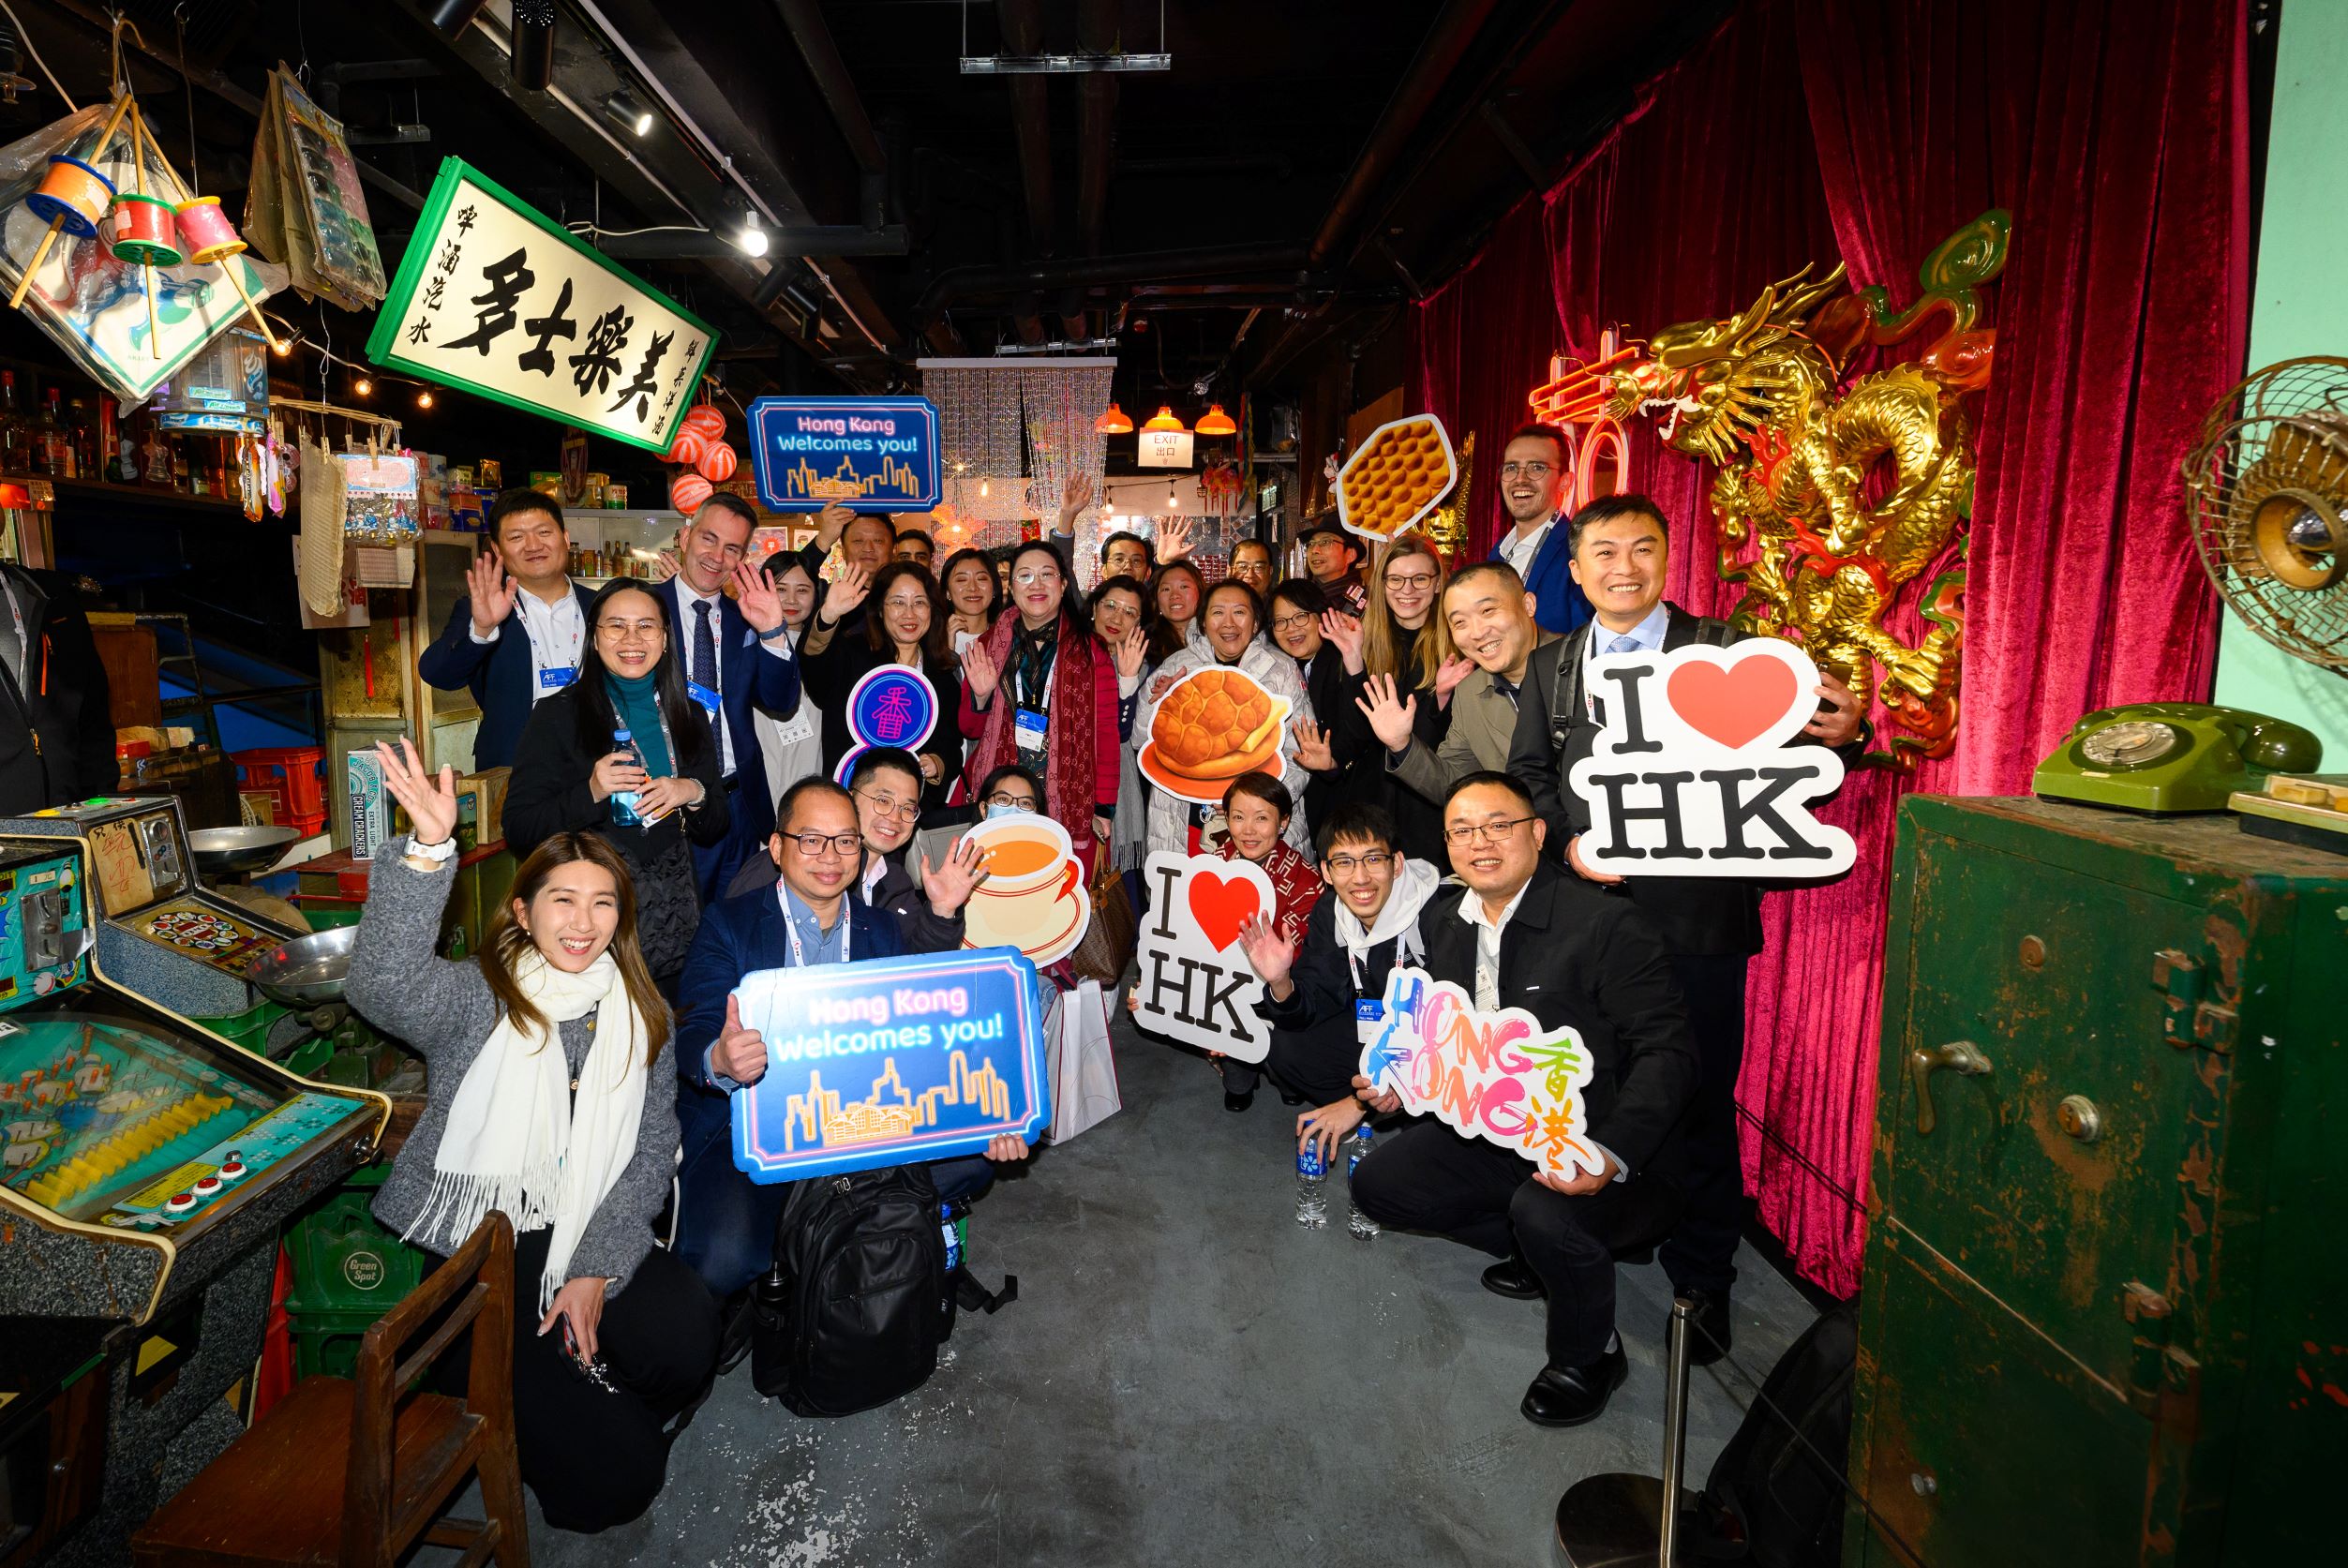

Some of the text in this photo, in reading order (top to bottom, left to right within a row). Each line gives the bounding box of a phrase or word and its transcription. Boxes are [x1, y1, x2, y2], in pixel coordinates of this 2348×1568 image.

[778, 435, 918, 455] Welcomes you!
[798, 416, 895, 435] Hong Kong
[1154, 434, 1179, 444] EXIT
[1156, 445, 1175, 456] 出口
[871, 685, 913, 739] 香
[1603, 665, 1664, 755] I
[352, 760, 377, 782] JACOB
[352, 796, 366, 855] CREAM CRACKERS
[1588, 765, 1833, 860] HK
[1151, 866, 1183, 941] I
[812, 987, 966, 1023] Hong Kong
[1144, 948, 1255, 1044] HK
[776, 1011, 1005, 1060] Welcomes you!
[1391, 976, 1537, 1076] HONG
[1367, 1023, 1539, 1137] KONG
[1518, 1037, 1593, 1171] 香港
[350, 1259, 377, 1271] Green
[354, 1270, 377, 1283] Spot
